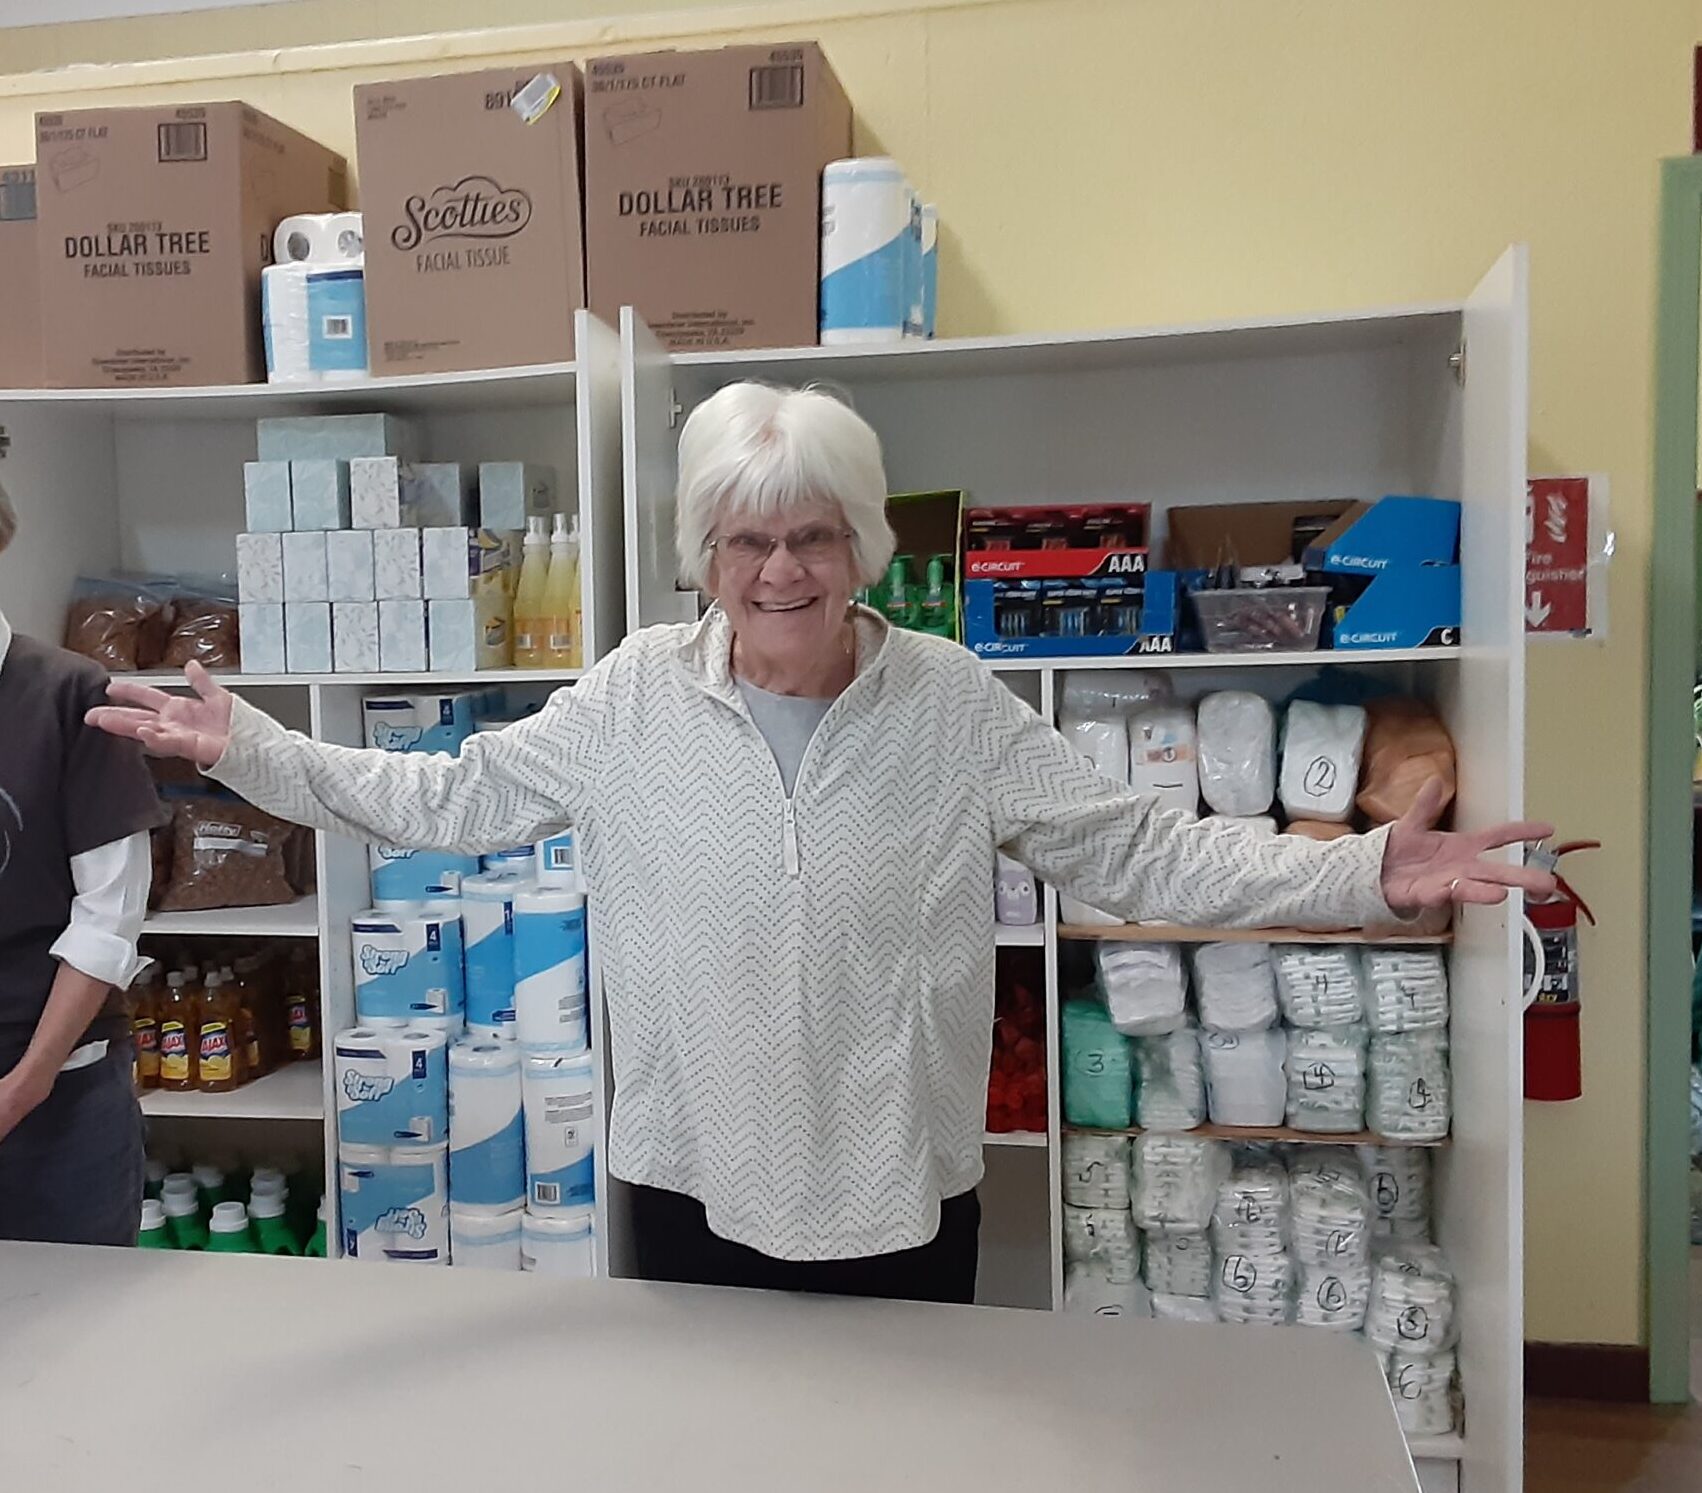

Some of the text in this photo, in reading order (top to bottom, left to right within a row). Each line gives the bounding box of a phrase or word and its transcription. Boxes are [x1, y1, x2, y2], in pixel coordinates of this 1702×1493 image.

[618, 182, 783, 217] DOLLAR TREE
[390, 191, 521, 252] Scotties
[639, 214, 761, 238] FACIAL TISSUES
[64, 230, 210, 259] DOLLAR TREE
[83, 259, 192, 279] FACIAL TISSUES
[415, 245, 511, 273] FACIAL TISSUE
[1107, 554, 1146, 574] AAA
[1138, 636, 1173, 654] AAA
[1441, 628, 1454, 645] C
[429, 934, 437, 942] 4
[1315, 973, 1329, 995] 4
[416, 1058, 423, 1069] 4
[1087, 1053, 1104, 1074] 3
[1399, 1364, 1422, 1400] 6
